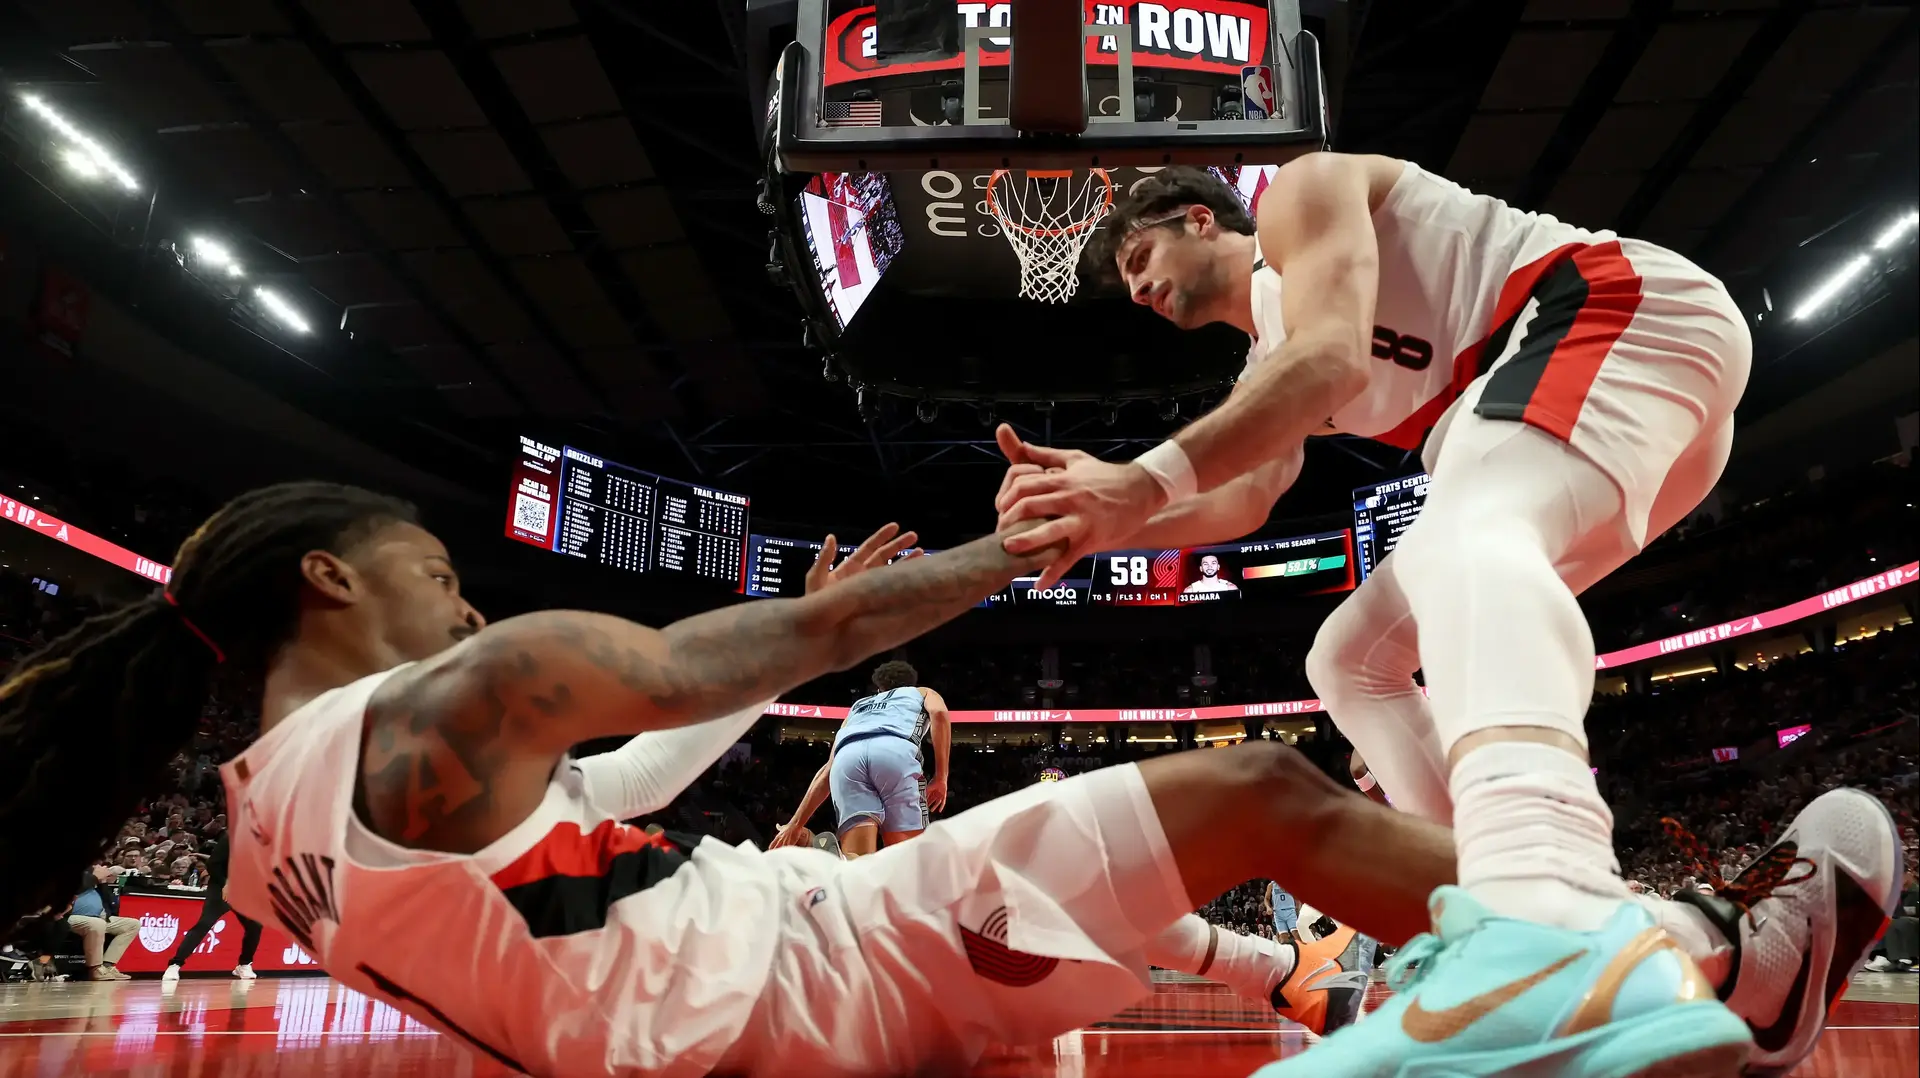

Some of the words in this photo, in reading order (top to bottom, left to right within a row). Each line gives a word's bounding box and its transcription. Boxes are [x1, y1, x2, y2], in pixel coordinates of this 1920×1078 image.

[1096, 4, 1124, 25] IN
[1138, 2, 1249, 61] ROW
[1102, 35, 1117, 51] A
[1248, 110, 1262, 119] NBA
[520, 435, 536, 448] TRAIL
[536, 442, 561, 458] BLAZERS
[544, 453, 556, 463] APP
[567, 449, 603, 468] GRIZZLIES
[518, 484, 551, 501] DOWNLOAD
[523, 478, 539, 490] SCAN
[540, 483, 548, 493] TO
[1376, 481, 1401, 495] STATS
[693, 487, 713, 499] TRAIL
[715, 492, 746, 505] BLAZERS
[17, 506, 36, 526] UP
[765, 539, 794, 547] GRIZZLIES
[1241, 545, 1253, 553] 3PT
[1254, 544, 1262, 552] FG
[1275, 541, 1290, 549] THIS
[1291, 538, 1316, 548] SEASON
[763, 547, 780, 555] WELLS
[135, 557, 163, 581] LOOK
[1110, 556, 1149, 586] 58
[1027, 585, 1077, 600] moda
[1822, 589, 1850, 609] LOOK
[1851, 576, 1886, 600] WHO'S
[1887, 569, 1903, 587] UP
[1180, 594, 1189, 602] 33
[1189, 593, 1220, 601] CAMARA
[1660, 635, 1684, 654] LOOK
[1685, 628, 1717, 649] WHO'S
[1718, 623, 1732, 640] UP
[789, 705, 800, 716] UP
[994, 711, 1013, 721] LOOK
[1015, 711, 1039, 721] WHO'S
[1040, 711, 1051, 721] UP
[1120, 710, 1138, 720] LOOK
[1140, 710, 1164, 720] WHO'S
[1165, 710, 1176, 720] UP
[1245, 704, 1264, 716] LOOK
[1266, 703, 1292, 715] WHO'S
[1292, 702, 1303, 713] UP
[139, 912, 180, 928] ripcity
